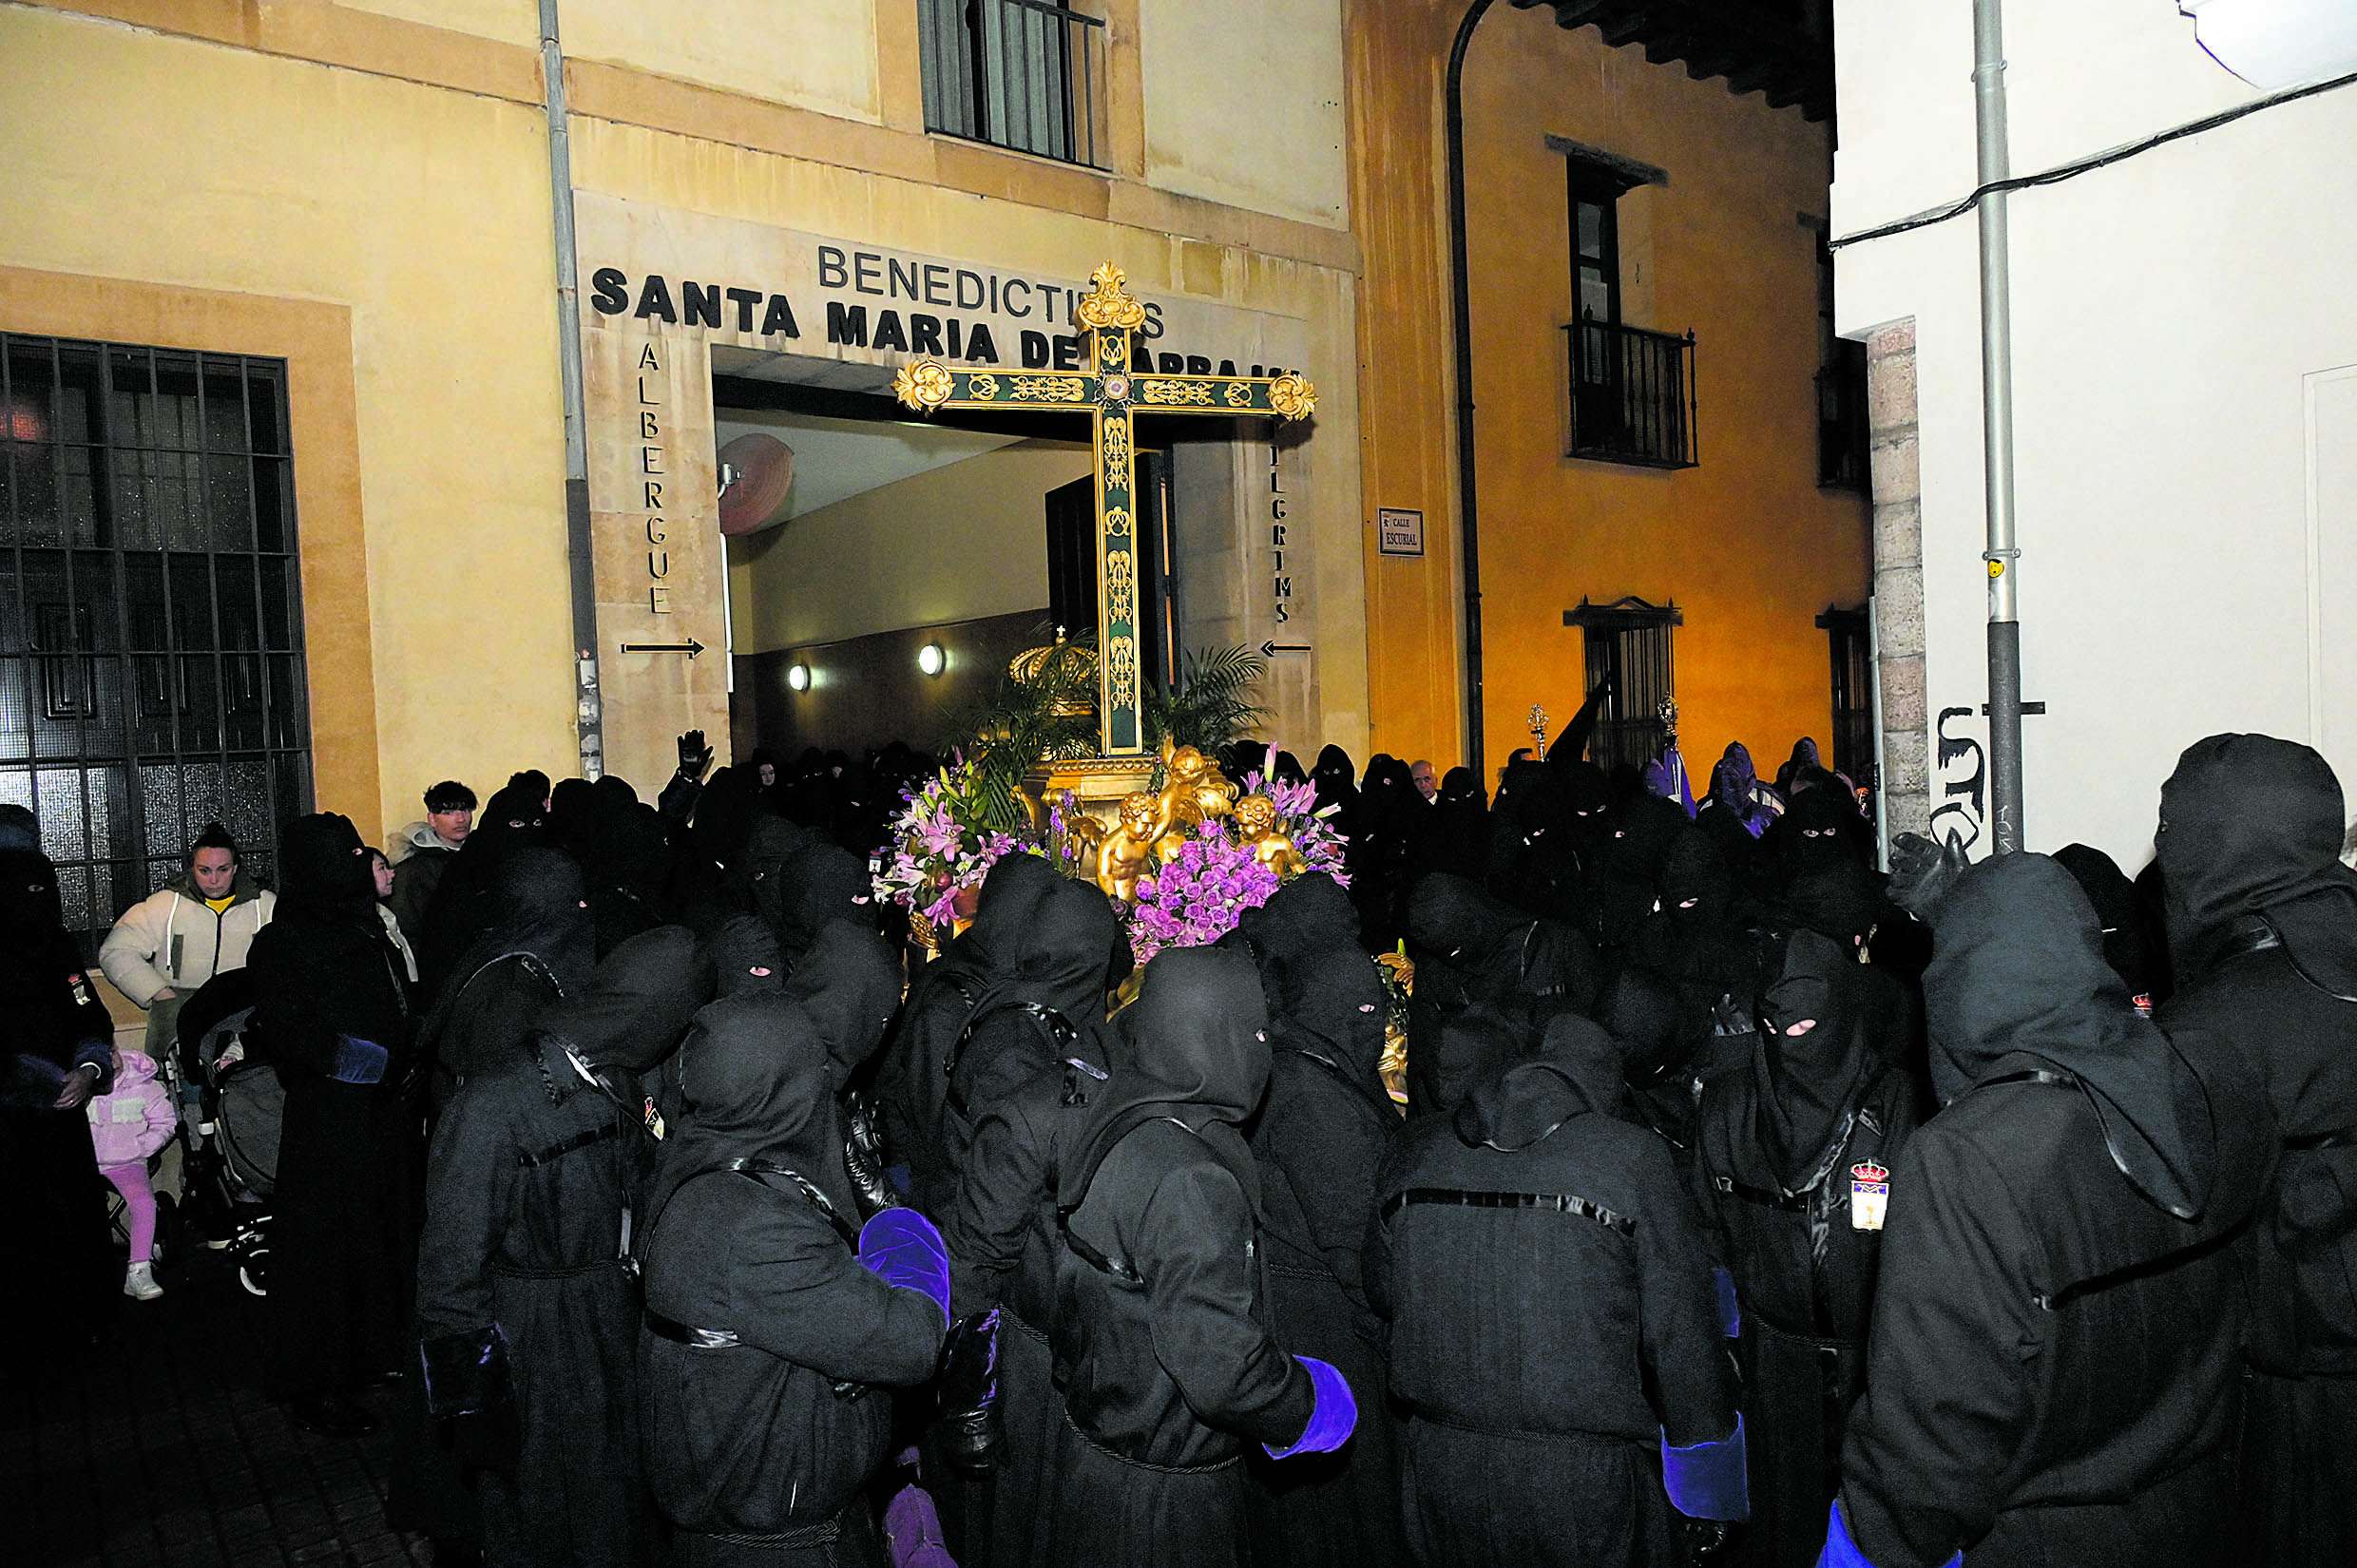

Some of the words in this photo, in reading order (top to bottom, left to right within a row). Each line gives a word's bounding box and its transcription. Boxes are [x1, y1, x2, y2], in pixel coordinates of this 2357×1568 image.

[591, 267, 800, 338] SANTA
[827, 301, 999, 363] MARIA
[1020, 330, 1080, 371] DE
[818, 245, 1164, 338] BENEDICTIS
[639, 343, 670, 613] ALBERGUE
[1393, 518, 1409, 527] CALLE
[1270, 432, 1292, 623] ILGRIMS
[1387, 532, 1417, 545] ESCURIAL
